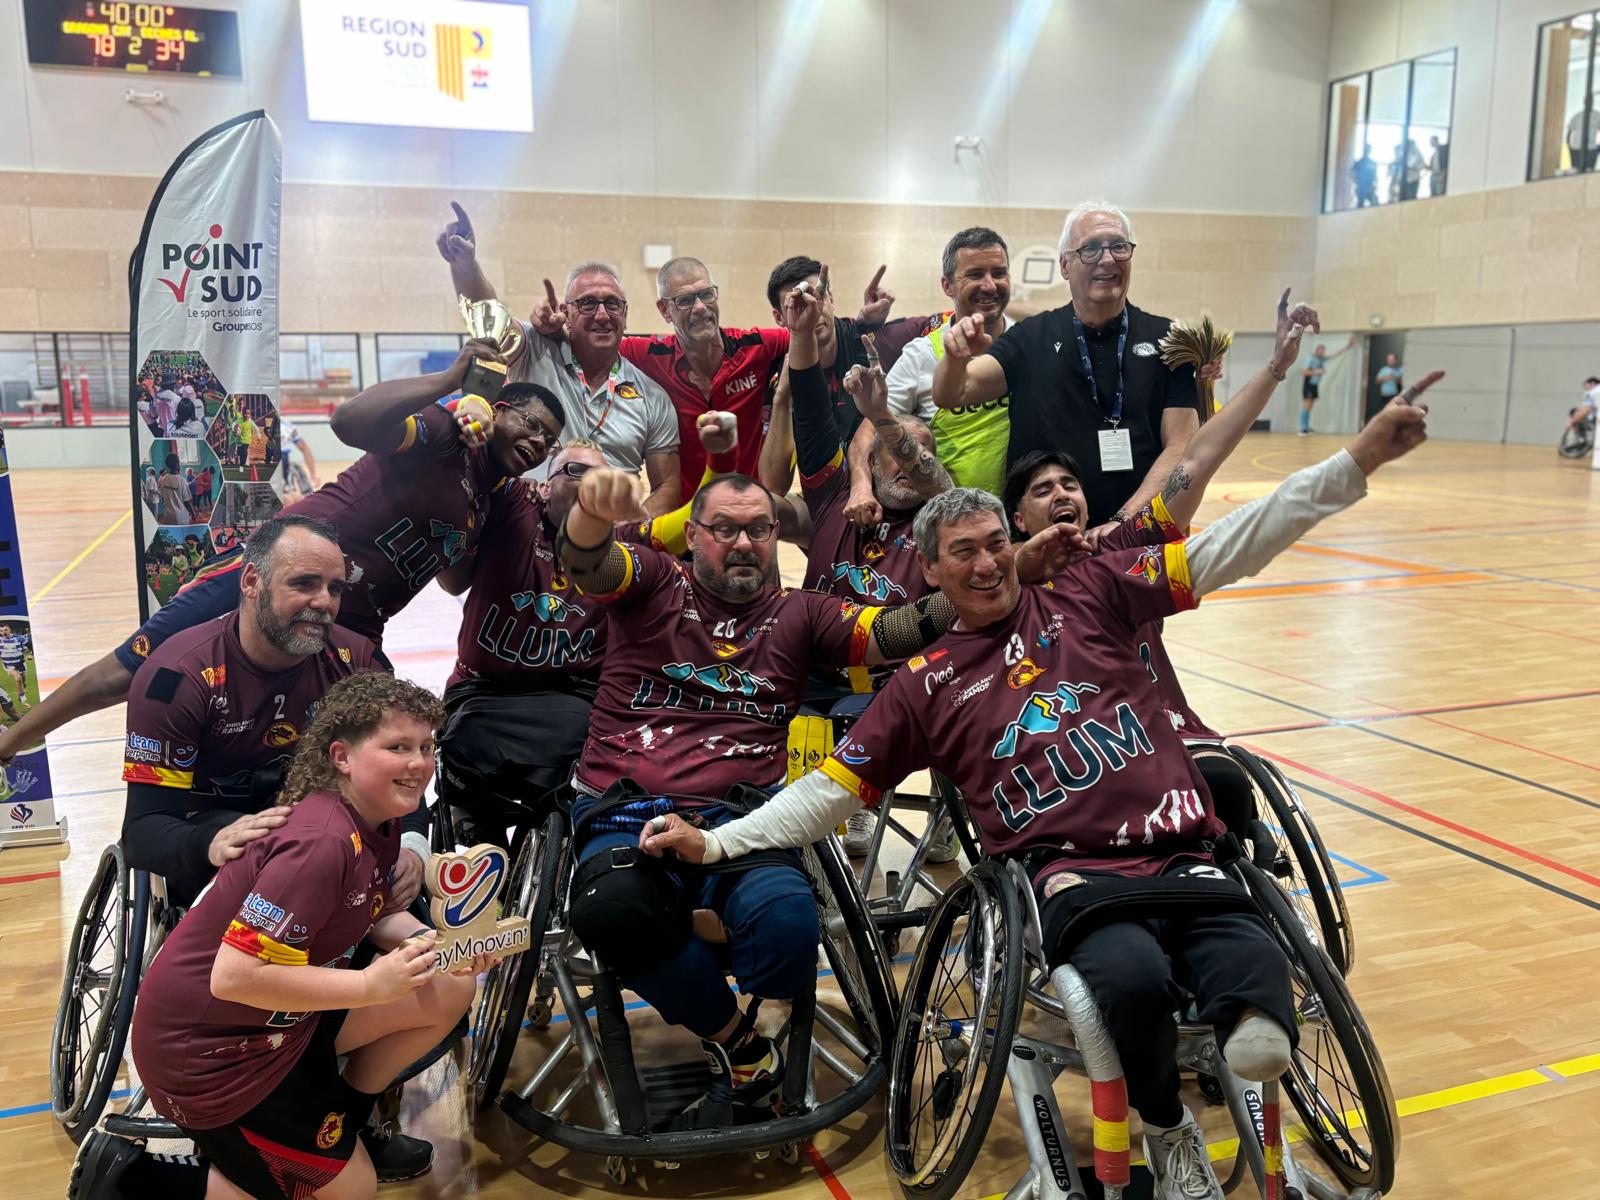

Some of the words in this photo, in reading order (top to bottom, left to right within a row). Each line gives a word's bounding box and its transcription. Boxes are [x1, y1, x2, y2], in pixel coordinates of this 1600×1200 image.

[342, 16, 425, 37] REGION
[128, 36, 142, 55] 2
[156, 39, 185, 61] 34
[384, 40, 427, 58] SUD
[162, 243, 263, 271] POINT
[201, 275, 262, 303] SUD
[187, 308, 198, 318] Le
[200, 308, 226, 319] sport
[228, 307, 262, 318] solidaire
[725, 371, 758, 395] KINÉ
[375, 517, 444, 591] LLU
[477, 604, 596, 668] LLUM
[712, 618, 738, 639] 20
[1003, 633, 1025, 666] 23
[274, 694, 286, 720] 2
[130, 731, 161, 754] team
[992, 703, 1155, 833] LLUM
[250, 893, 285, 923] team
[1034, 1098, 1070, 1188] WOLTURNUS
